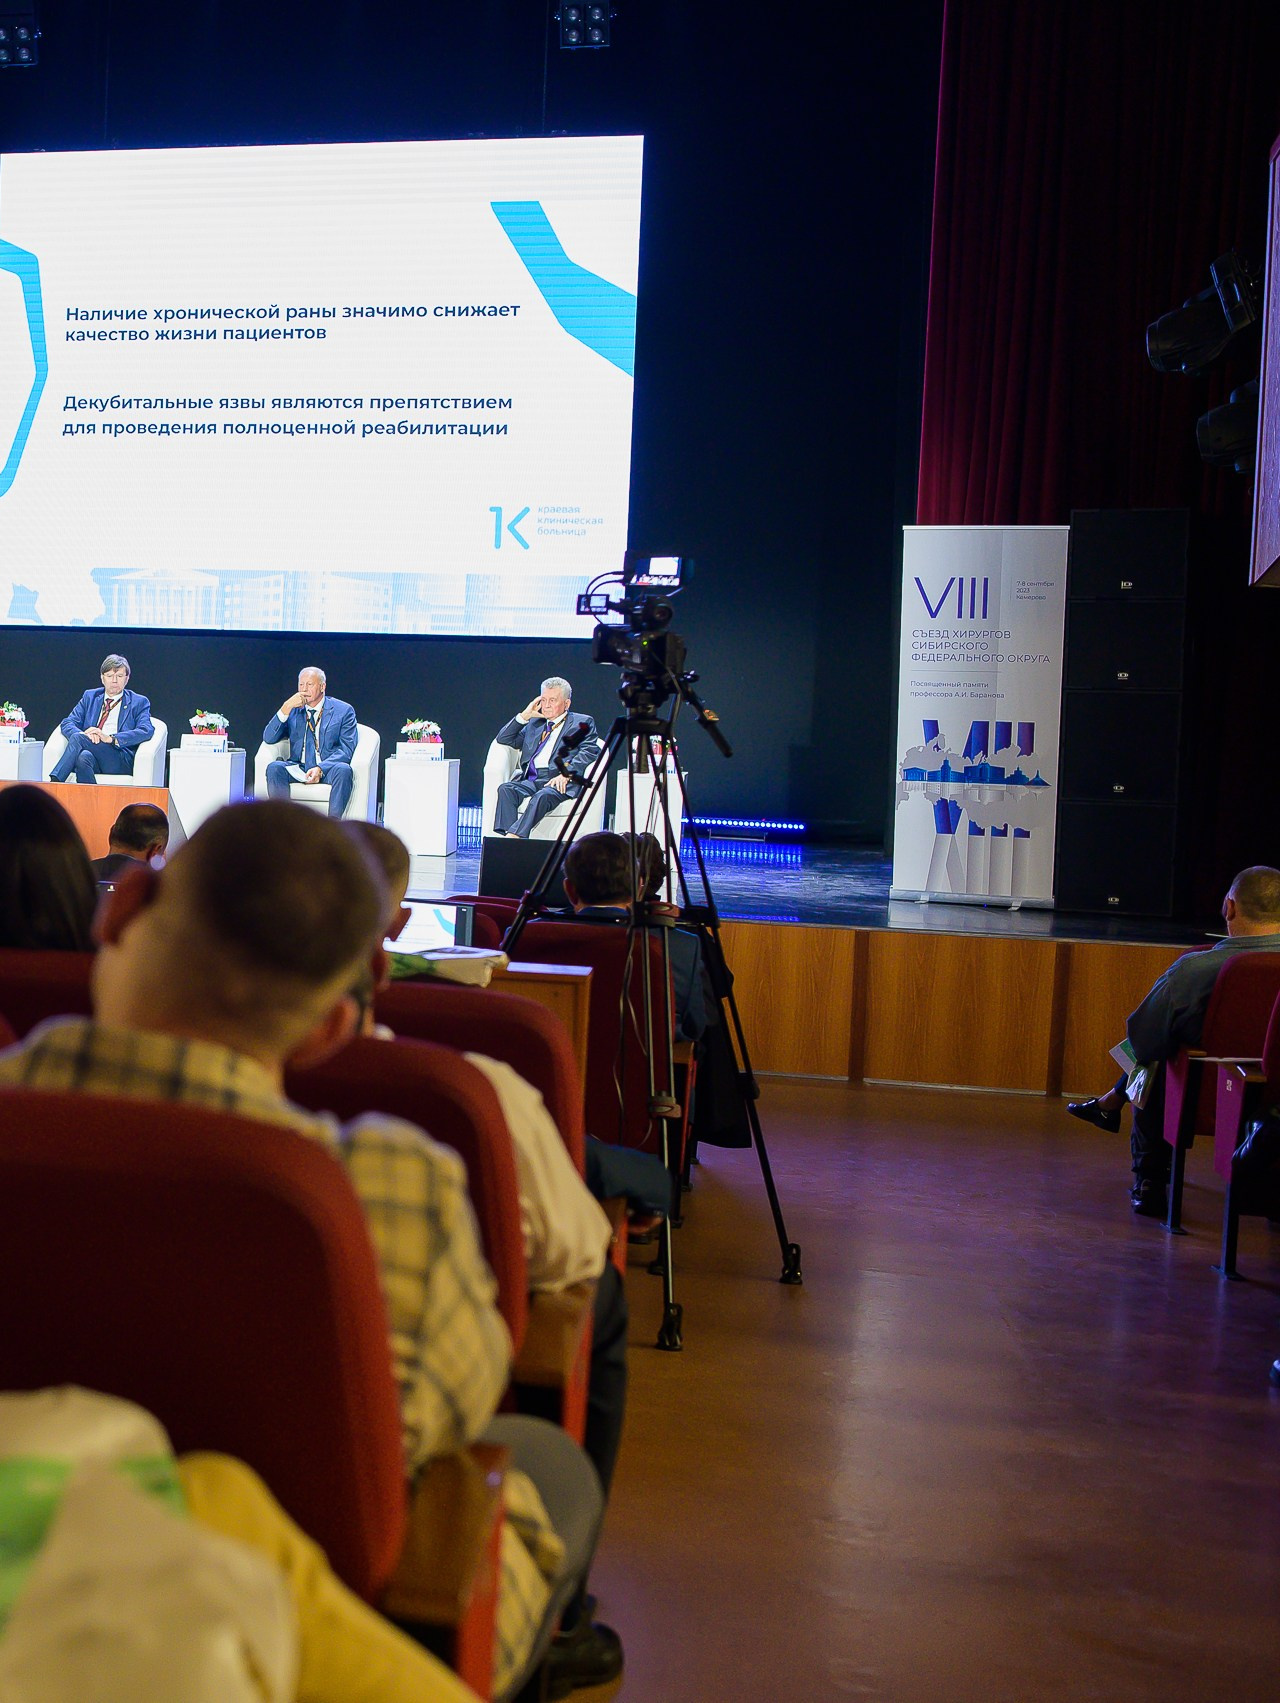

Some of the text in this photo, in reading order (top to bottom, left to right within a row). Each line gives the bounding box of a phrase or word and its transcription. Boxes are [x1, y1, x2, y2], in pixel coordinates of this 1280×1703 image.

[66, 303, 521, 323] Наличие хронической раны значимо снижает
[65, 326, 327, 342] качество жизни пациентов
[63, 394, 513, 413] Декубитальные язвы являются препятствием
[62, 419, 509, 439] для проведения полноценной реабилитации
[538, 505, 581, 515] краевая
[537, 516, 604, 525] клиническая
[537, 526, 587, 537] больница
[914, 577, 989, 619] VIII
[912, 629, 1011, 640] СЪЕЗД ХИРУРГОВ
[911, 641, 989, 651] СИБИРСКОГО
[911, 653, 1051, 664] ФЕДЕРАЛЬНОГО ОКРУГА
[910, 691, 953, 699] профессора
[970, 691, 1005, 699] Баранова
